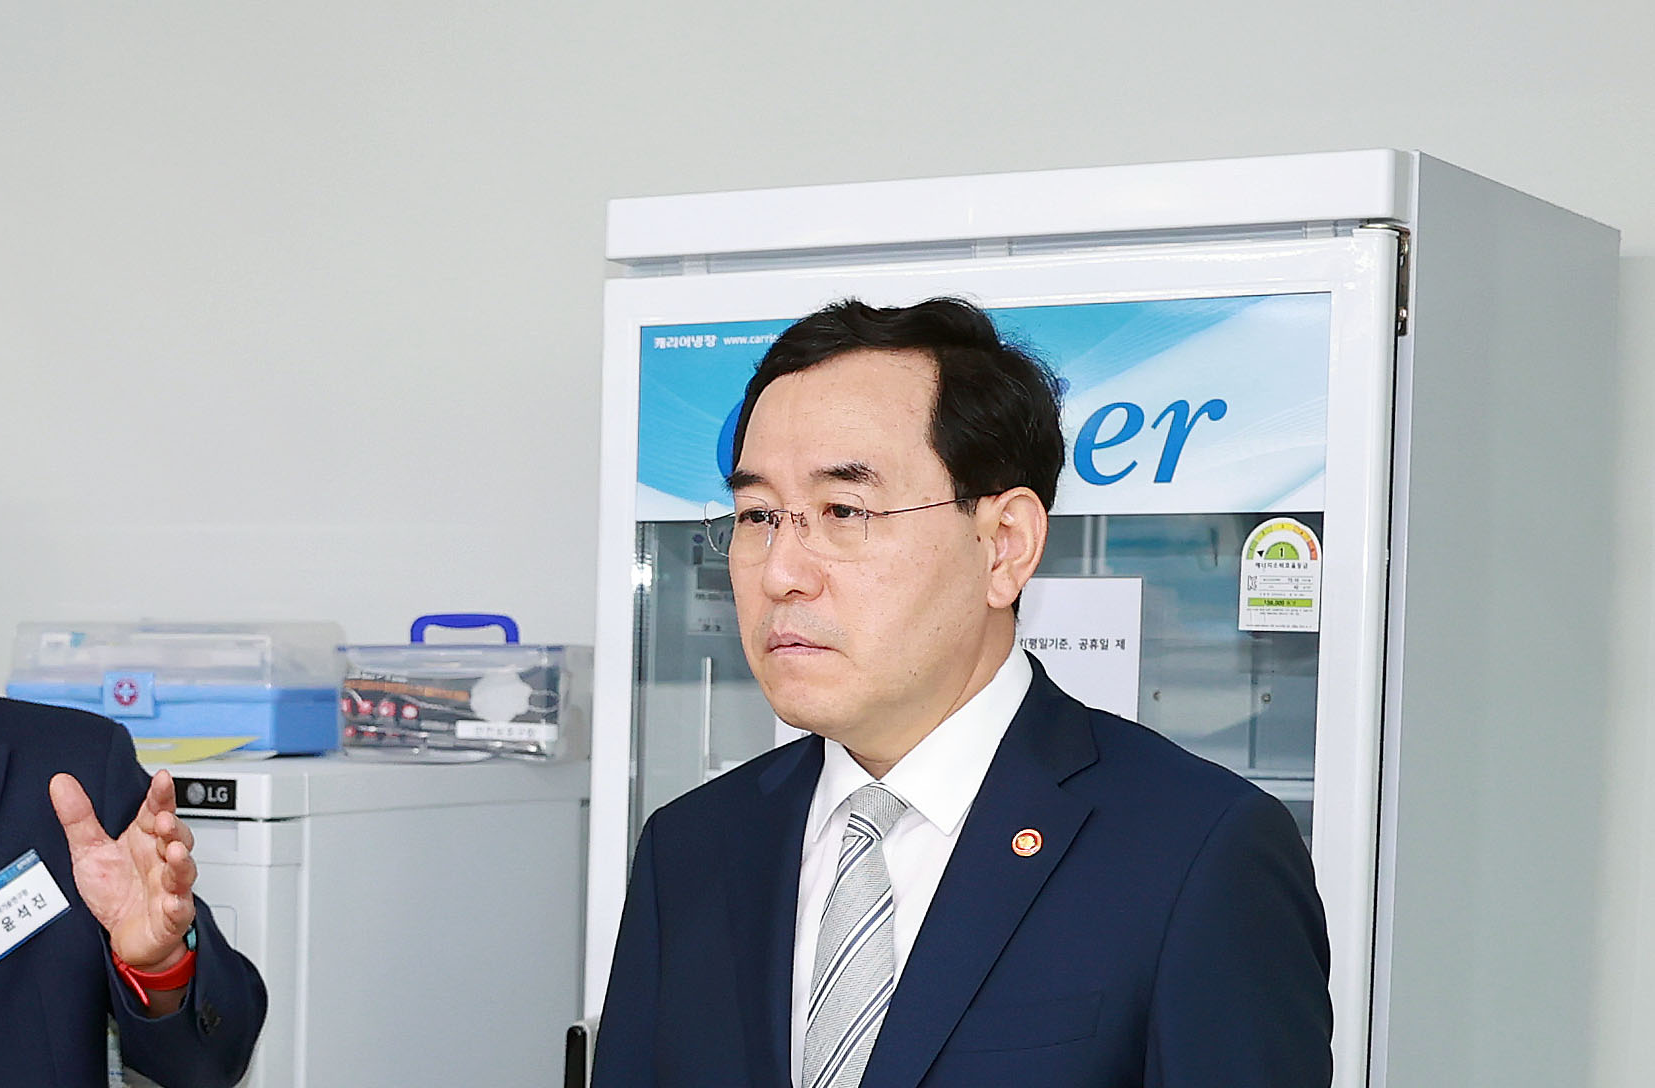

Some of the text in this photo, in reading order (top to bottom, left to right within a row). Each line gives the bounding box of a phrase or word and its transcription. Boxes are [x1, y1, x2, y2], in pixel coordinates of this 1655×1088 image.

[654, 334, 718, 349] 캐리어냉장
[1078, 638, 1109, 651] 공휴일
[1115, 638, 1126, 651] 제
[207, 785, 228, 803] LG
